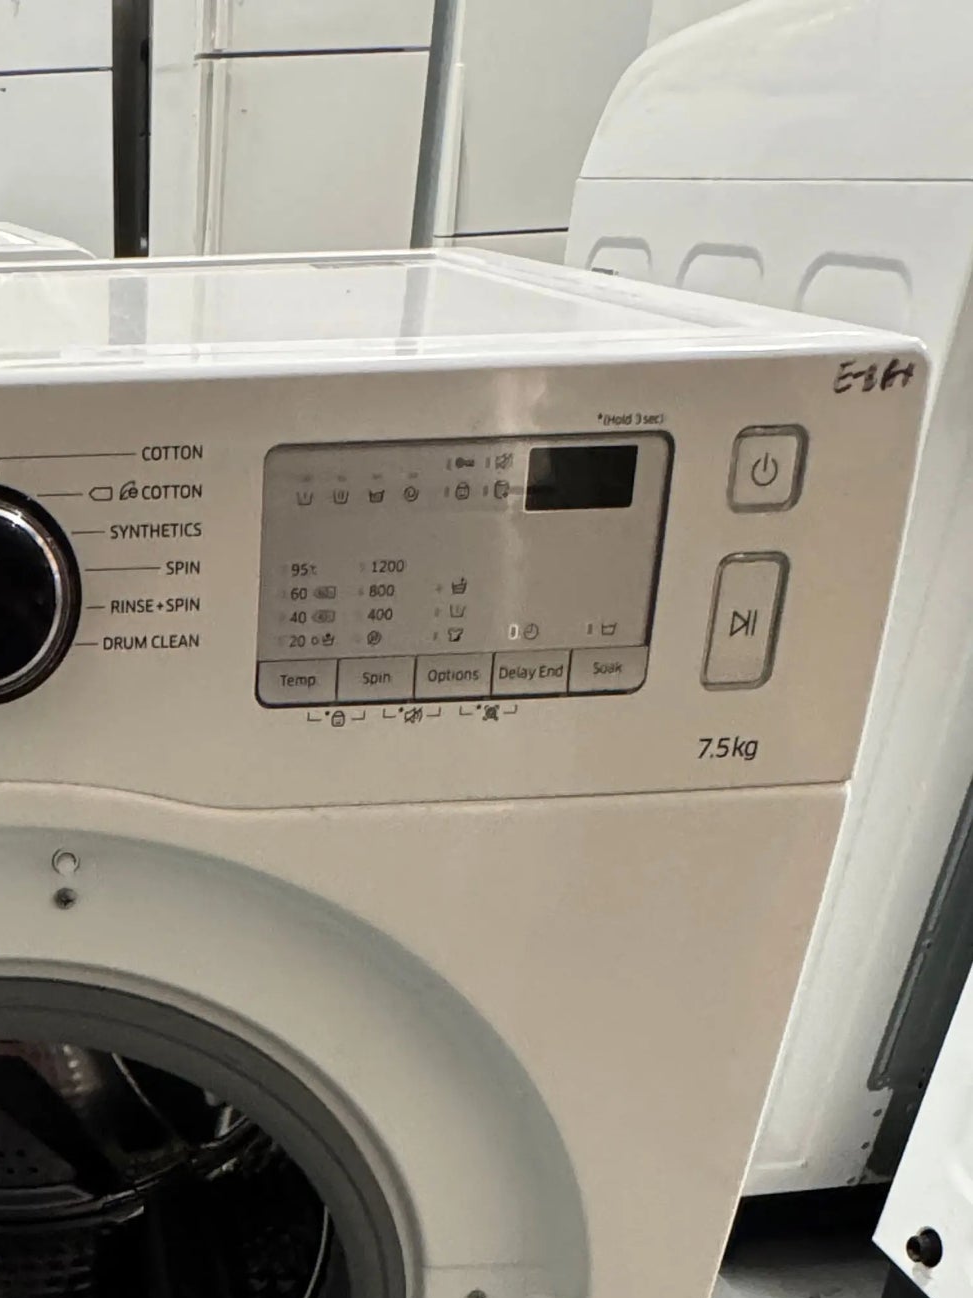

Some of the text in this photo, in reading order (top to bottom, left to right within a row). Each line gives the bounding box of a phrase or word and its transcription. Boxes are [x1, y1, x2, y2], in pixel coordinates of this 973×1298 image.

[142, 445, 204, 461] COTTON
[141, 484, 203, 500] COTTON
[110, 523, 202, 540] SYNTHETICS
[166, 560, 201, 576] SPIN
[372, 560, 405, 573] 1200
[290, 587, 308, 600] 60
[369, 584, 395, 597] 800
[289, 611, 307, 624] 40
[367, 608, 393, 621] 400
[103, 634, 200, 651] DRUM CLEAN
[289, 634, 306, 648] 20
[498, 664, 564, 681] Delay End
[593, 661, 623, 675] Soak
[280, 674, 316, 688] Temp
[362, 671, 391, 685] Spin
[428, 667, 480, 684] Options
[698, 735, 758, 761] 7.5kg
